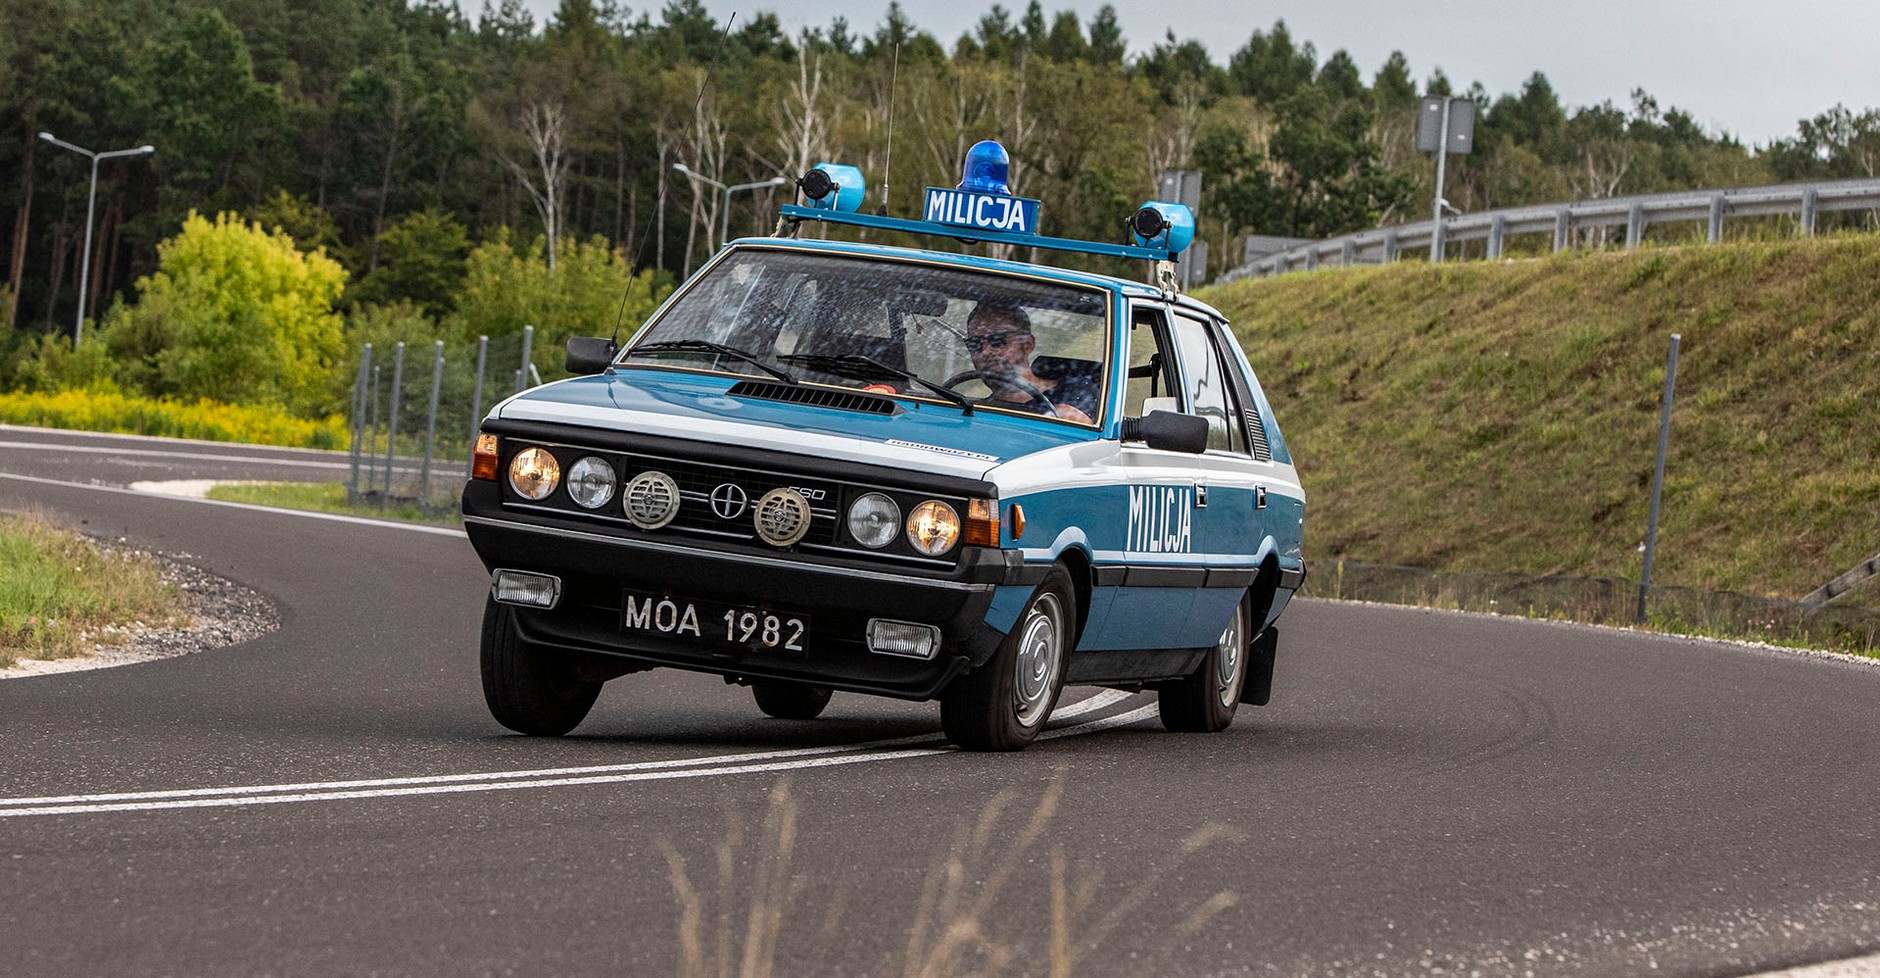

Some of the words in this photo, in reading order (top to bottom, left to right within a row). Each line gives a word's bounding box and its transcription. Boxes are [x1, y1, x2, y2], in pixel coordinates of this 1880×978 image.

[927, 190, 1025, 231] MILICJA
[1126, 485, 1191, 553] MILICJA
[626, 596, 701, 637] MOA
[723, 609, 804, 651] 1982
